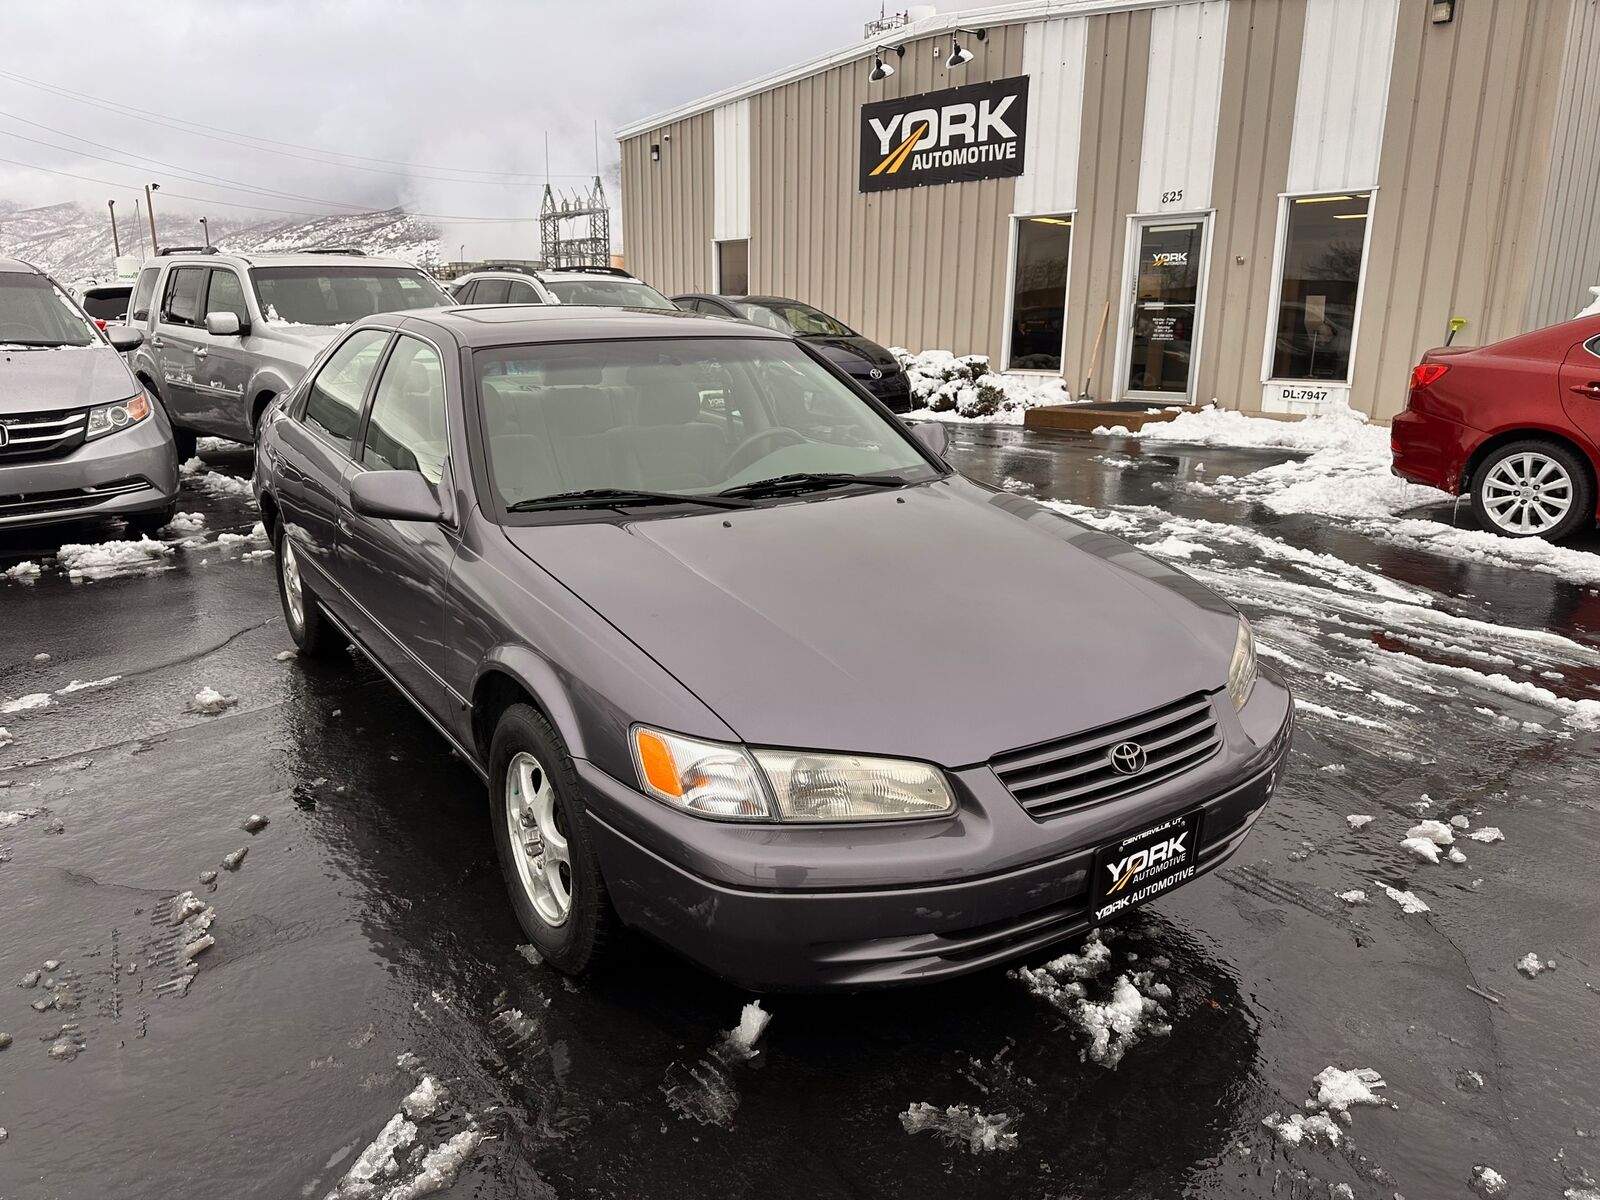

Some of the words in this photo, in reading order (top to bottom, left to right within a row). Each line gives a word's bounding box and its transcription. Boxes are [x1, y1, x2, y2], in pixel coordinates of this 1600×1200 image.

[868, 95, 1018, 156] YORK
[911, 141, 1017, 171] AUTOMOTIVE
[1161, 189, 1183, 204] 825
[1152, 252, 1188, 262] YORK
[1282, 389, 1328, 401] DL:7947
[1122, 821, 1171, 846] CENTERVILLE,
[1172, 816, 1182, 826] UT
[1106, 831, 1189, 883] YORK
[1132, 852, 1187, 884] AUTOMOTIVE
[1095, 895, 1130, 920] YORK
[1131, 865, 1195, 903] AUTOMOTIVE
